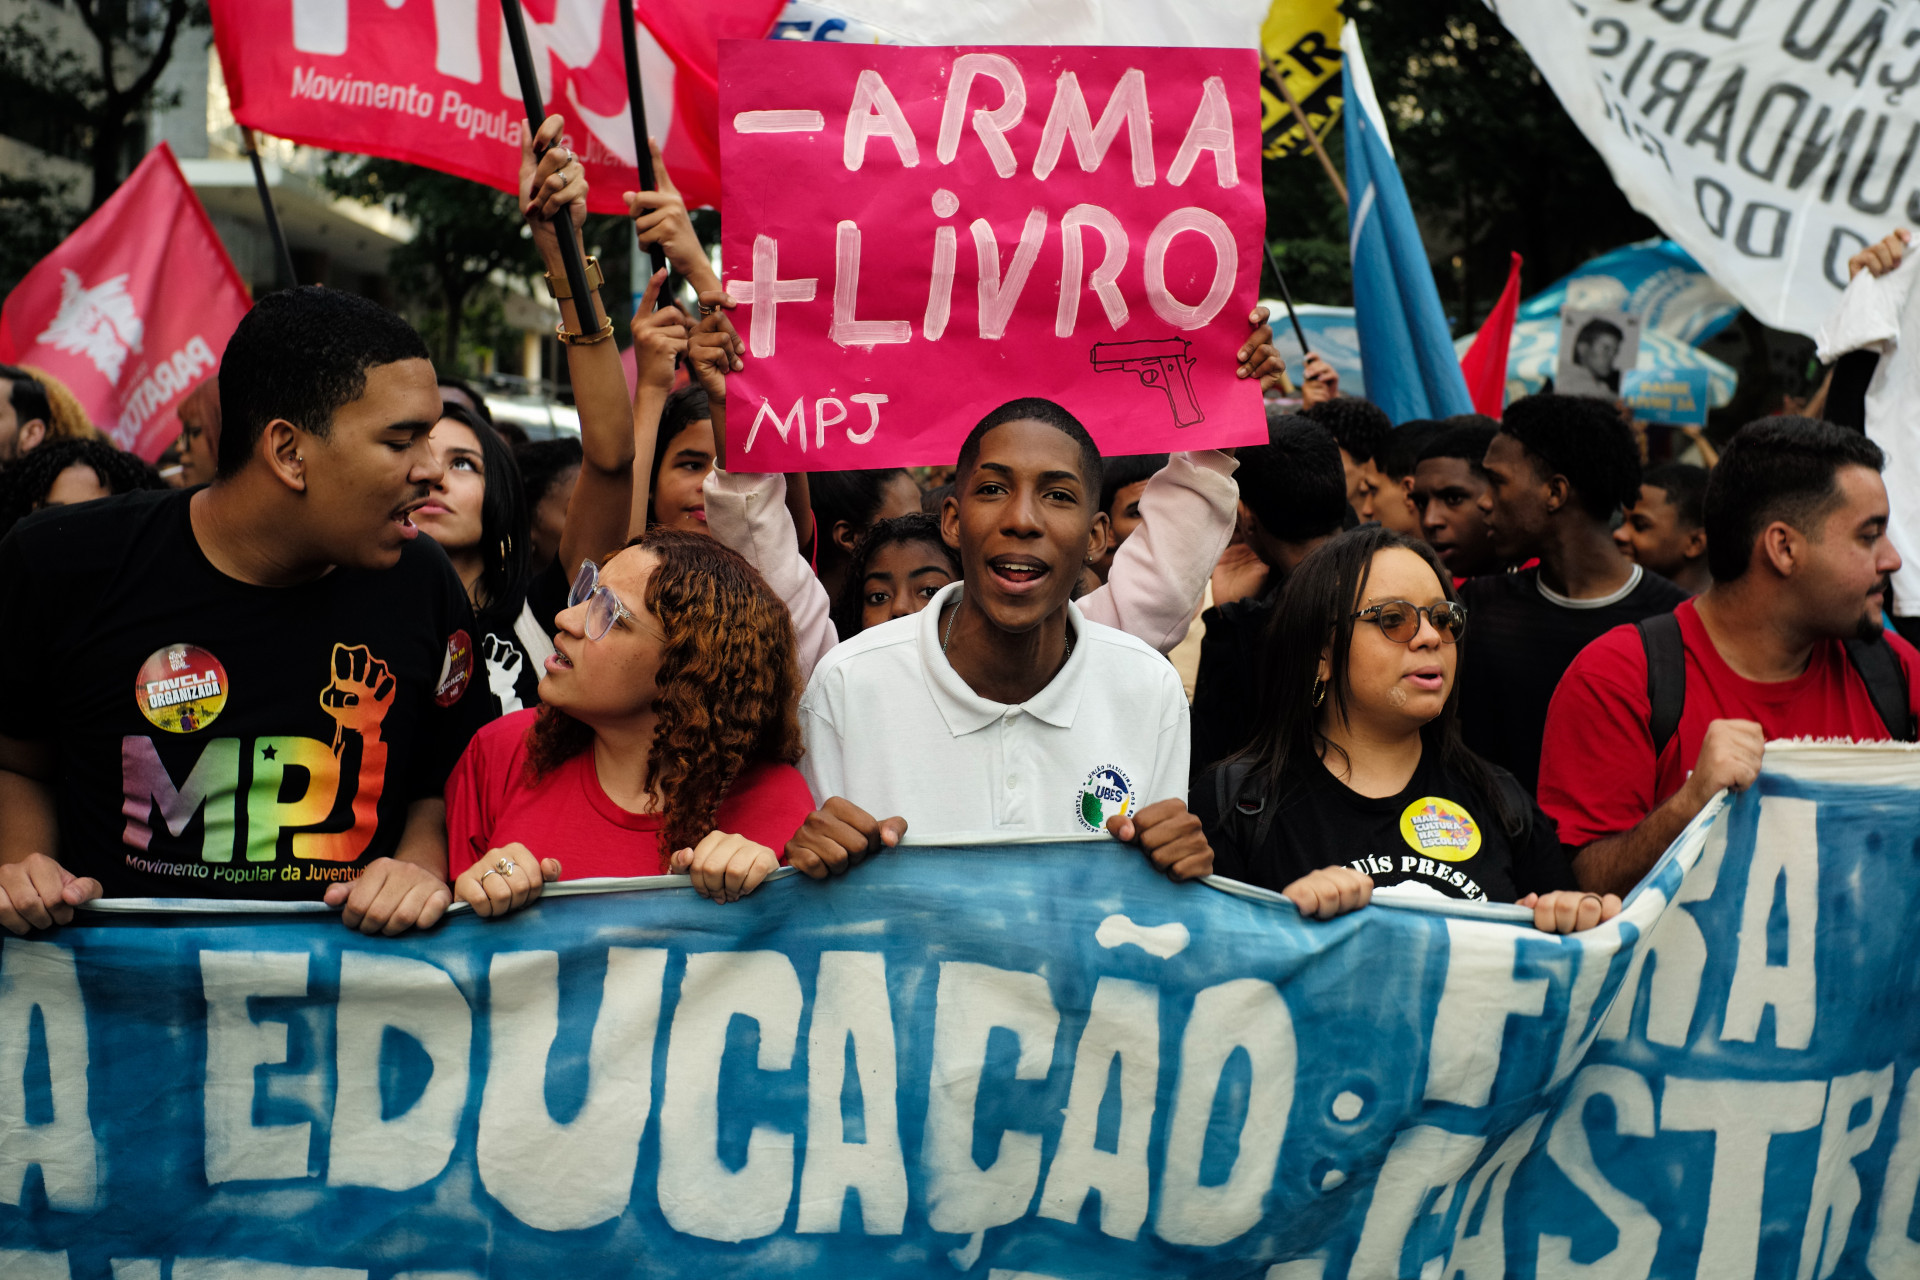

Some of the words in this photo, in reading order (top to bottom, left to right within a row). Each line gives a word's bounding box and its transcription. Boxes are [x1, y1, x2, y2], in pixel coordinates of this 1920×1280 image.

[291, 66, 434, 118] Movimento
[439, 90, 523, 147] Popula
[745, 393, 889, 454] MPJ
[147, 669, 218, 695] FAVELA
[149, 681, 221, 709] ORGANIZADA
[121, 735, 388, 863] MPJ
[1095, 785, 1123, 803] UBES
[1411, 813, 1439, 825] MAIS
[1415, 821, 1461, 832] CULTURA
[1418, 829, 1440, 840] NAS
[1421, 837, 1468, 848] ESCOLAS!
[125, 854, 209, 879] Movimento
[213, 865, 277, 884] Popular
[281, 864, 301, 881] da
[1341, 854, 1394, 877] UÍS
[0, 938, 98, 1214] A
